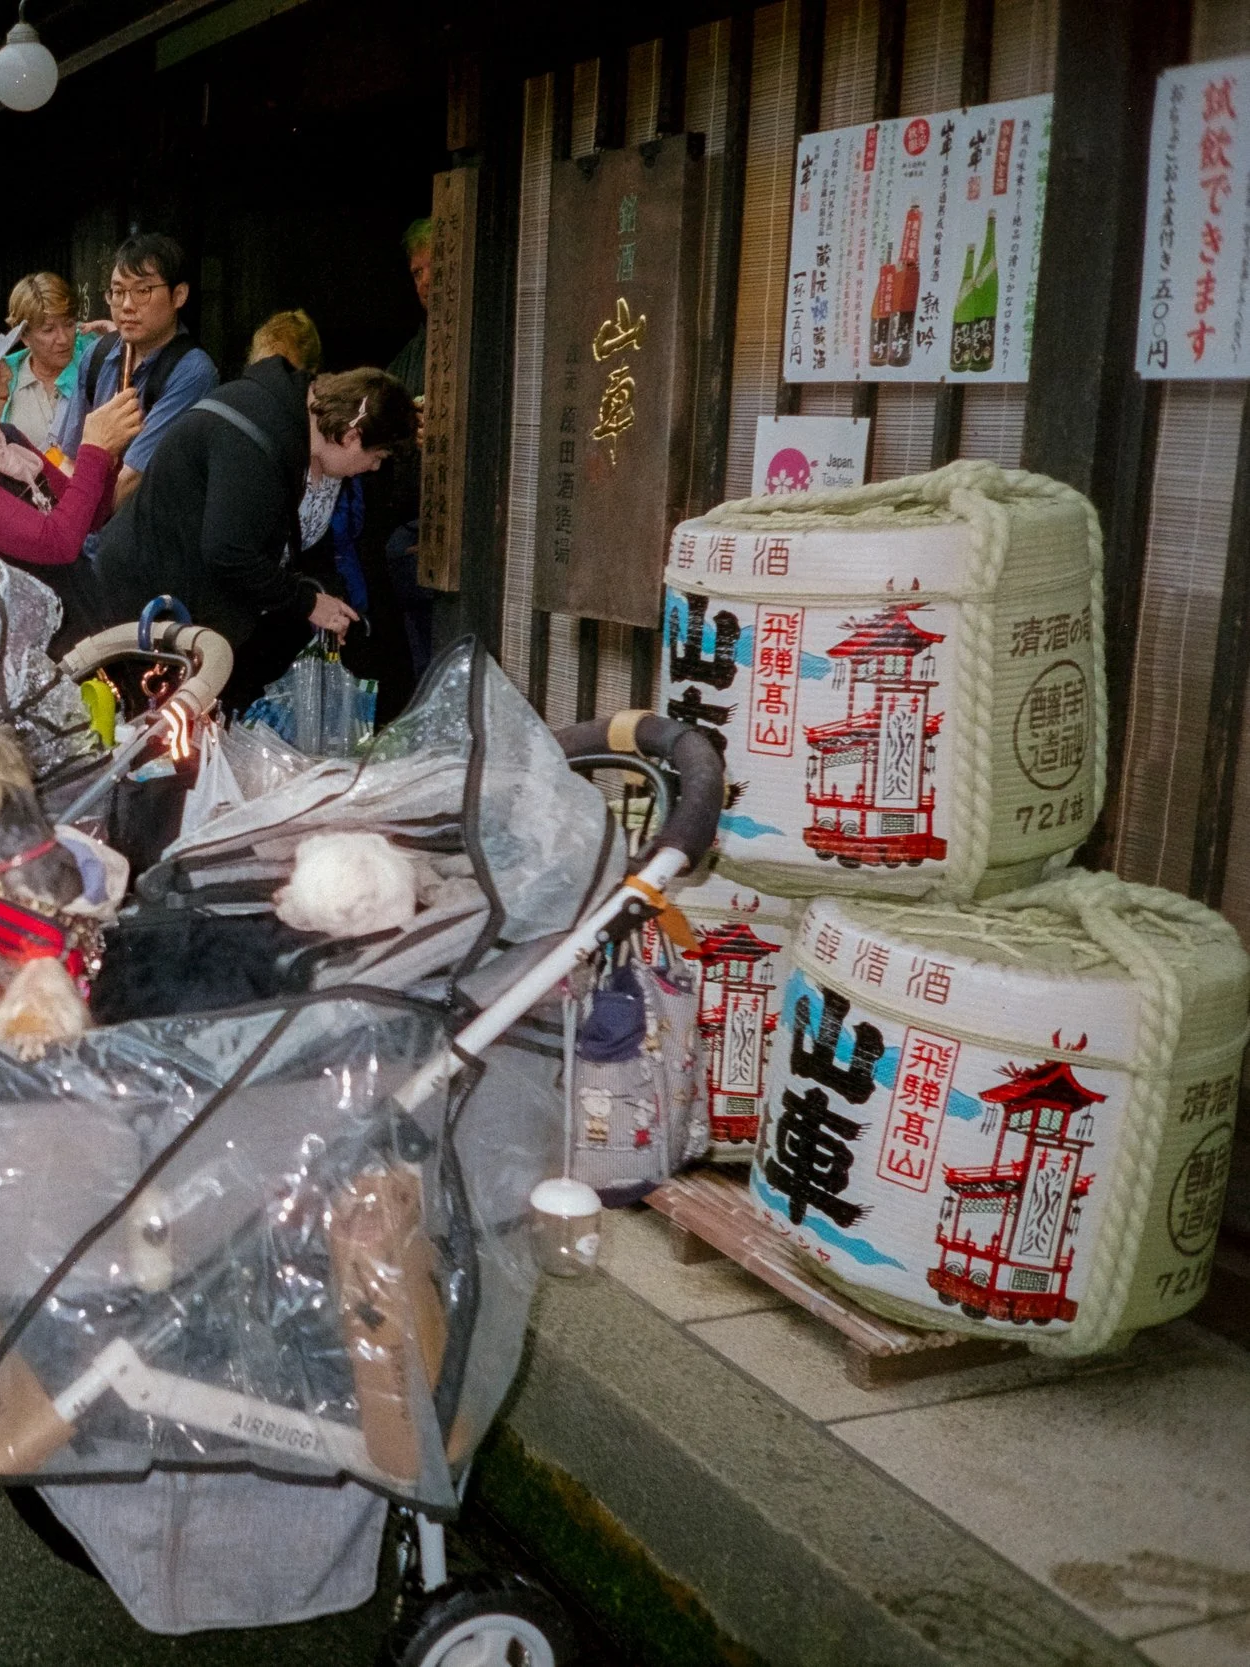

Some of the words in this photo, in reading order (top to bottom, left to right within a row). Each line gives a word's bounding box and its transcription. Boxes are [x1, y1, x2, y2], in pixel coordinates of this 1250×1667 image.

[1187, 74, 1237, 363] 試飲できます
[590, 297, 647, 466] 山車
[765, 983, 885, 1228] 山車
